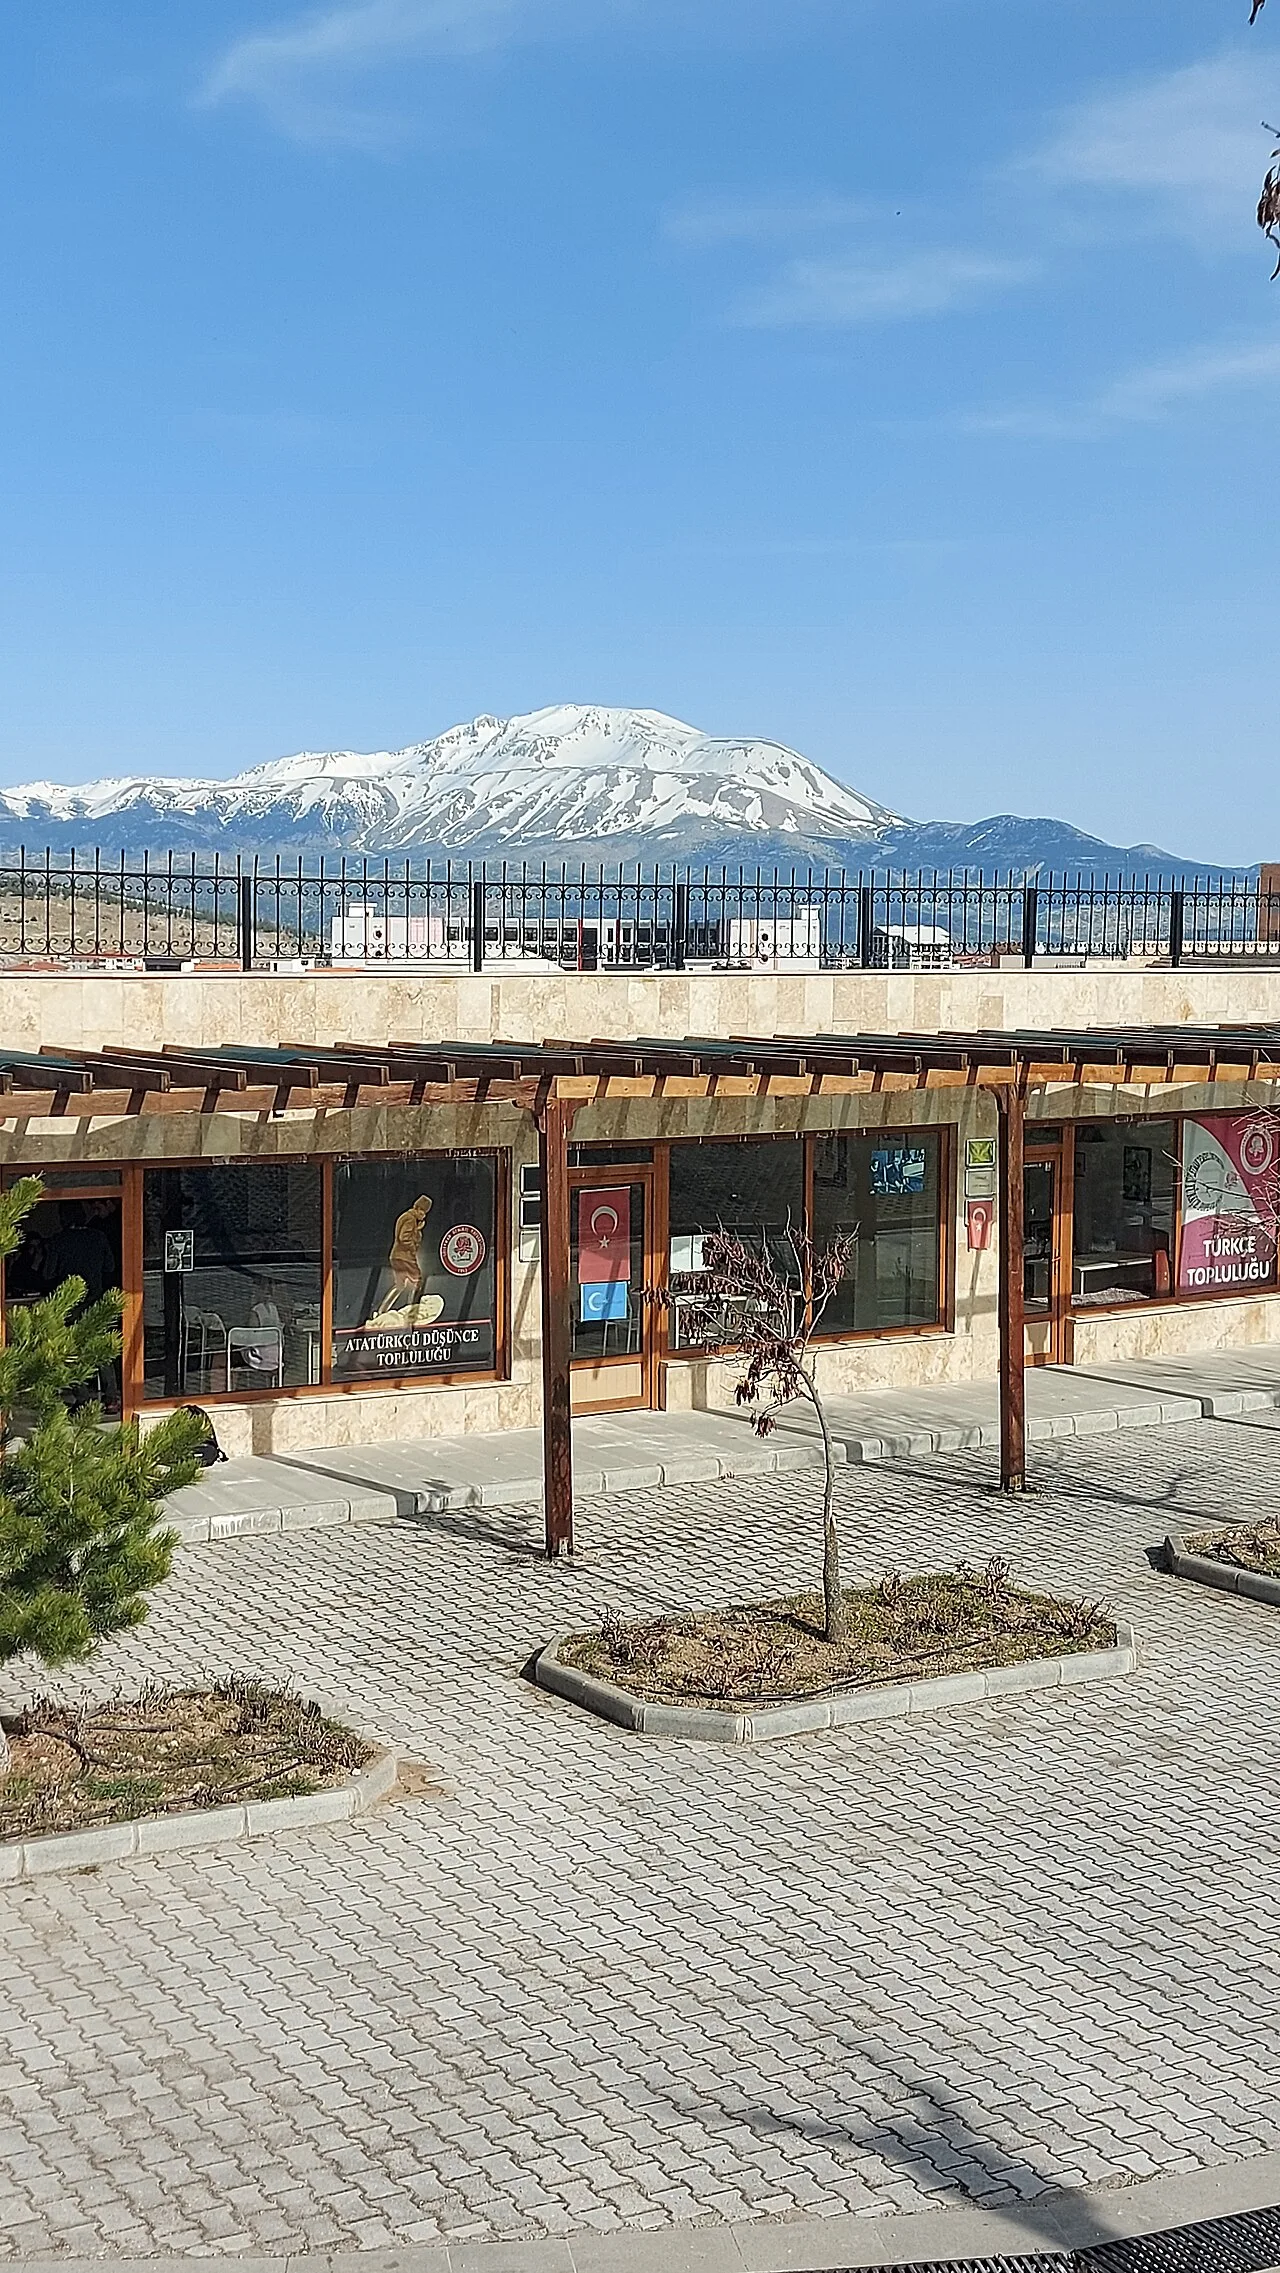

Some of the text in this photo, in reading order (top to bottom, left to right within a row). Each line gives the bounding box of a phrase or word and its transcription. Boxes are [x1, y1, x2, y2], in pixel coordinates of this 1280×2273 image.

[1203, 1234, 1256, 1257] TÜRKÇE
[1187, 1256, 1269, 1286] TOPLULUĞU
[345, 1329, 479, 1351] ATATÜRKÇÜ DÜŞÜNCE
[377, 1347, 451, 1366] TOPLULUĞU
